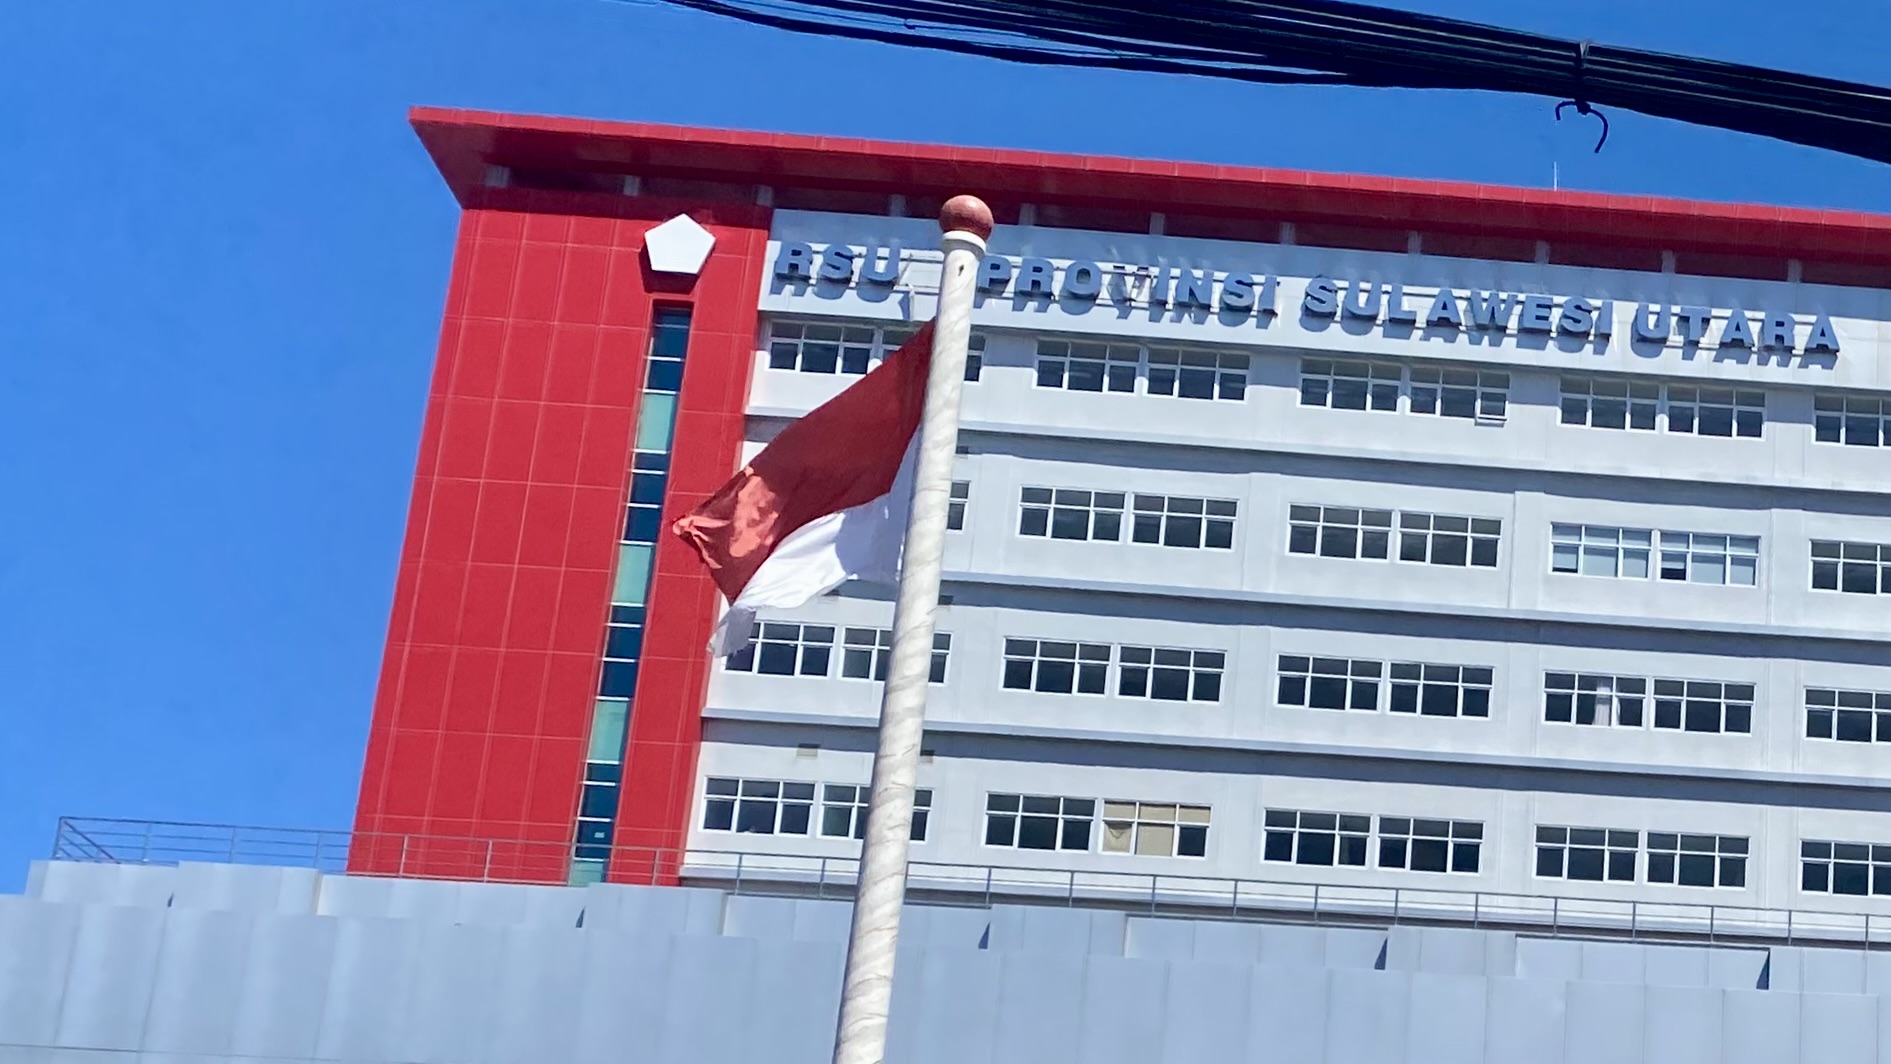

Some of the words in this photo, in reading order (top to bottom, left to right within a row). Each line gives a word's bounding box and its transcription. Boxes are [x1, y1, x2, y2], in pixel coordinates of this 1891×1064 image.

[774, 242, 901, 285] RSU
[1302, 275, 1615, 339] SULAWESI
[1634, 302, 1842, 354] UTARA
